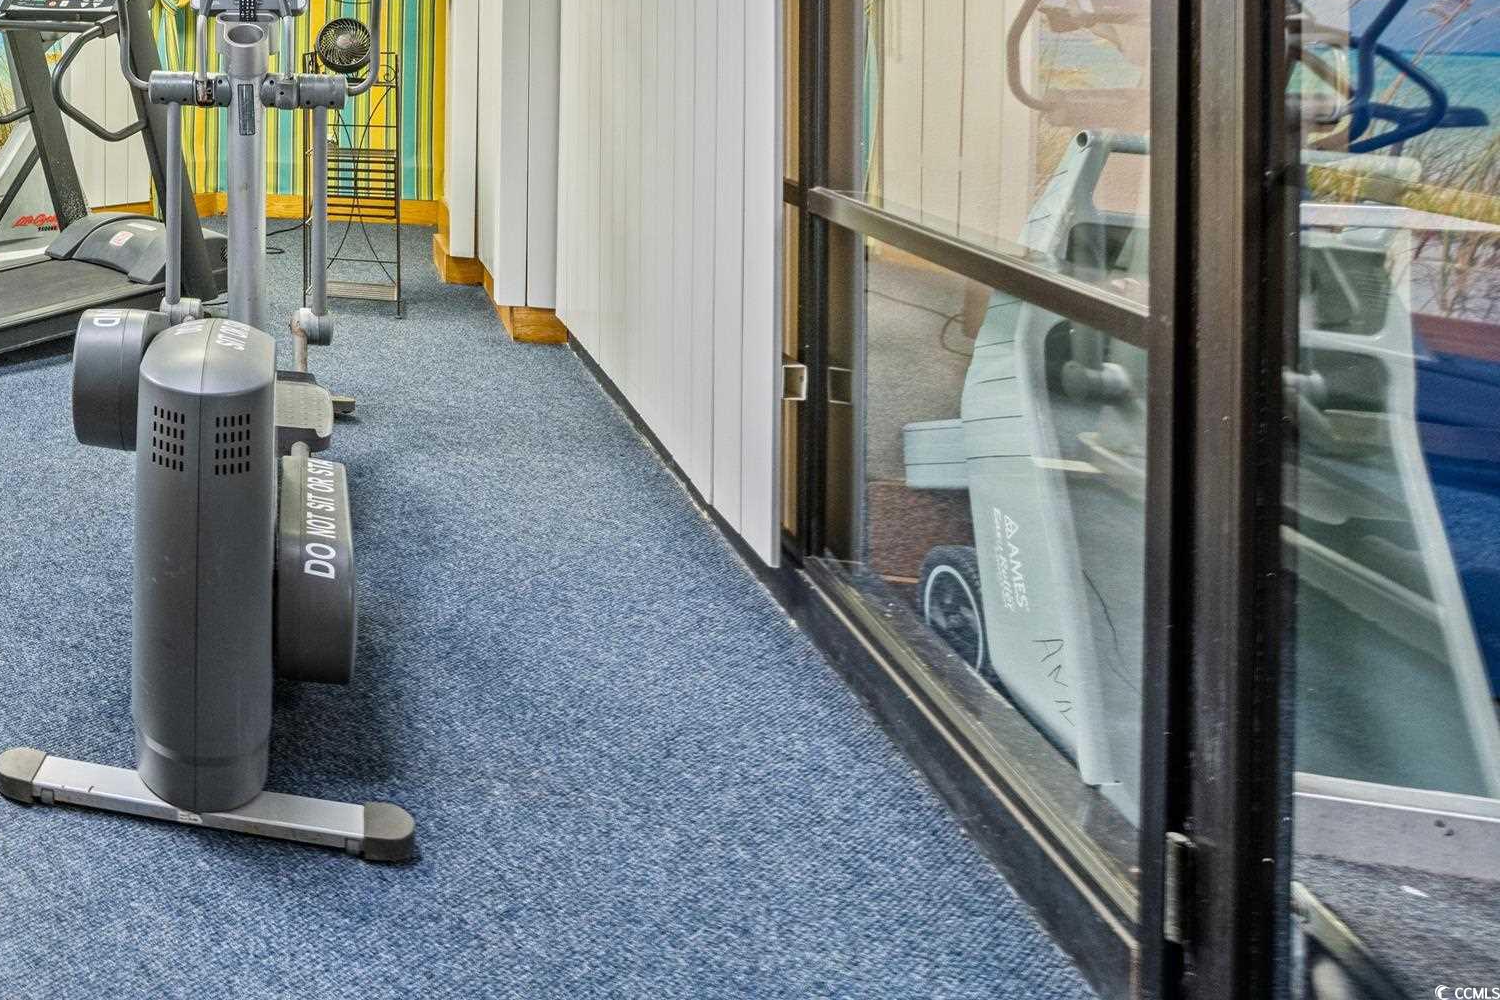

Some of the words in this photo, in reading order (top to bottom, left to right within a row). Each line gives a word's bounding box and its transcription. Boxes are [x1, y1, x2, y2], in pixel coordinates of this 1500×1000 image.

[307, 476, 335, 493] OR
[306, 493, 335, 511] SIT
[306, 512, 336, 539] NOT
[304, 542, 336, 579] DO
[1007, 541, 1029, 612] AMES
